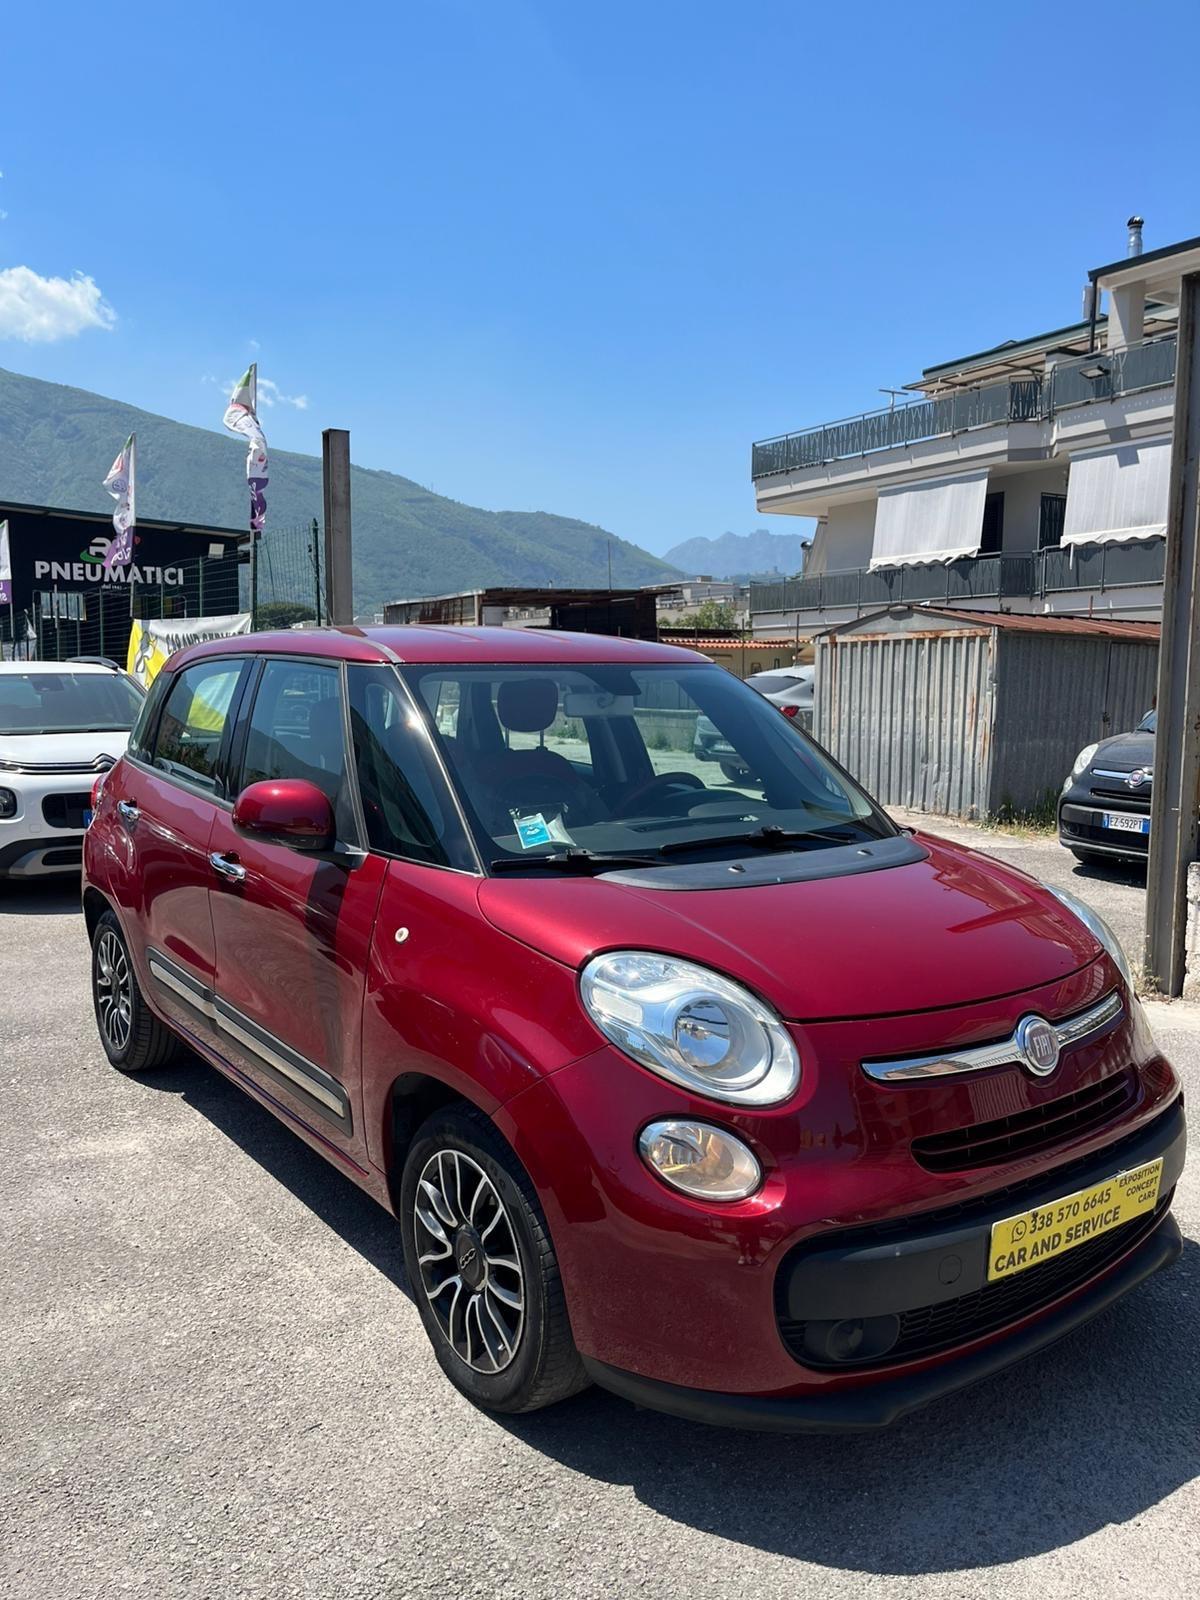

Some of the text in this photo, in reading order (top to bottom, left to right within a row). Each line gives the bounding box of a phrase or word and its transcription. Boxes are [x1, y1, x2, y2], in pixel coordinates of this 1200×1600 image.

[35, 561, 184, 585] PNEUMATICI
[1033, 1034, 1053, 1058] FIAT
[1119, 1162, 1160, 1188] EXPOSITION
[1127, 1176, 1158, 1197] CONCEPT
[1138, 1189, 1156, 1203] CARS
[1029, 1188, 1112, 1235] 338 570 6645
[994, 1205, 1121, 1272] CAR AND SERVICE
